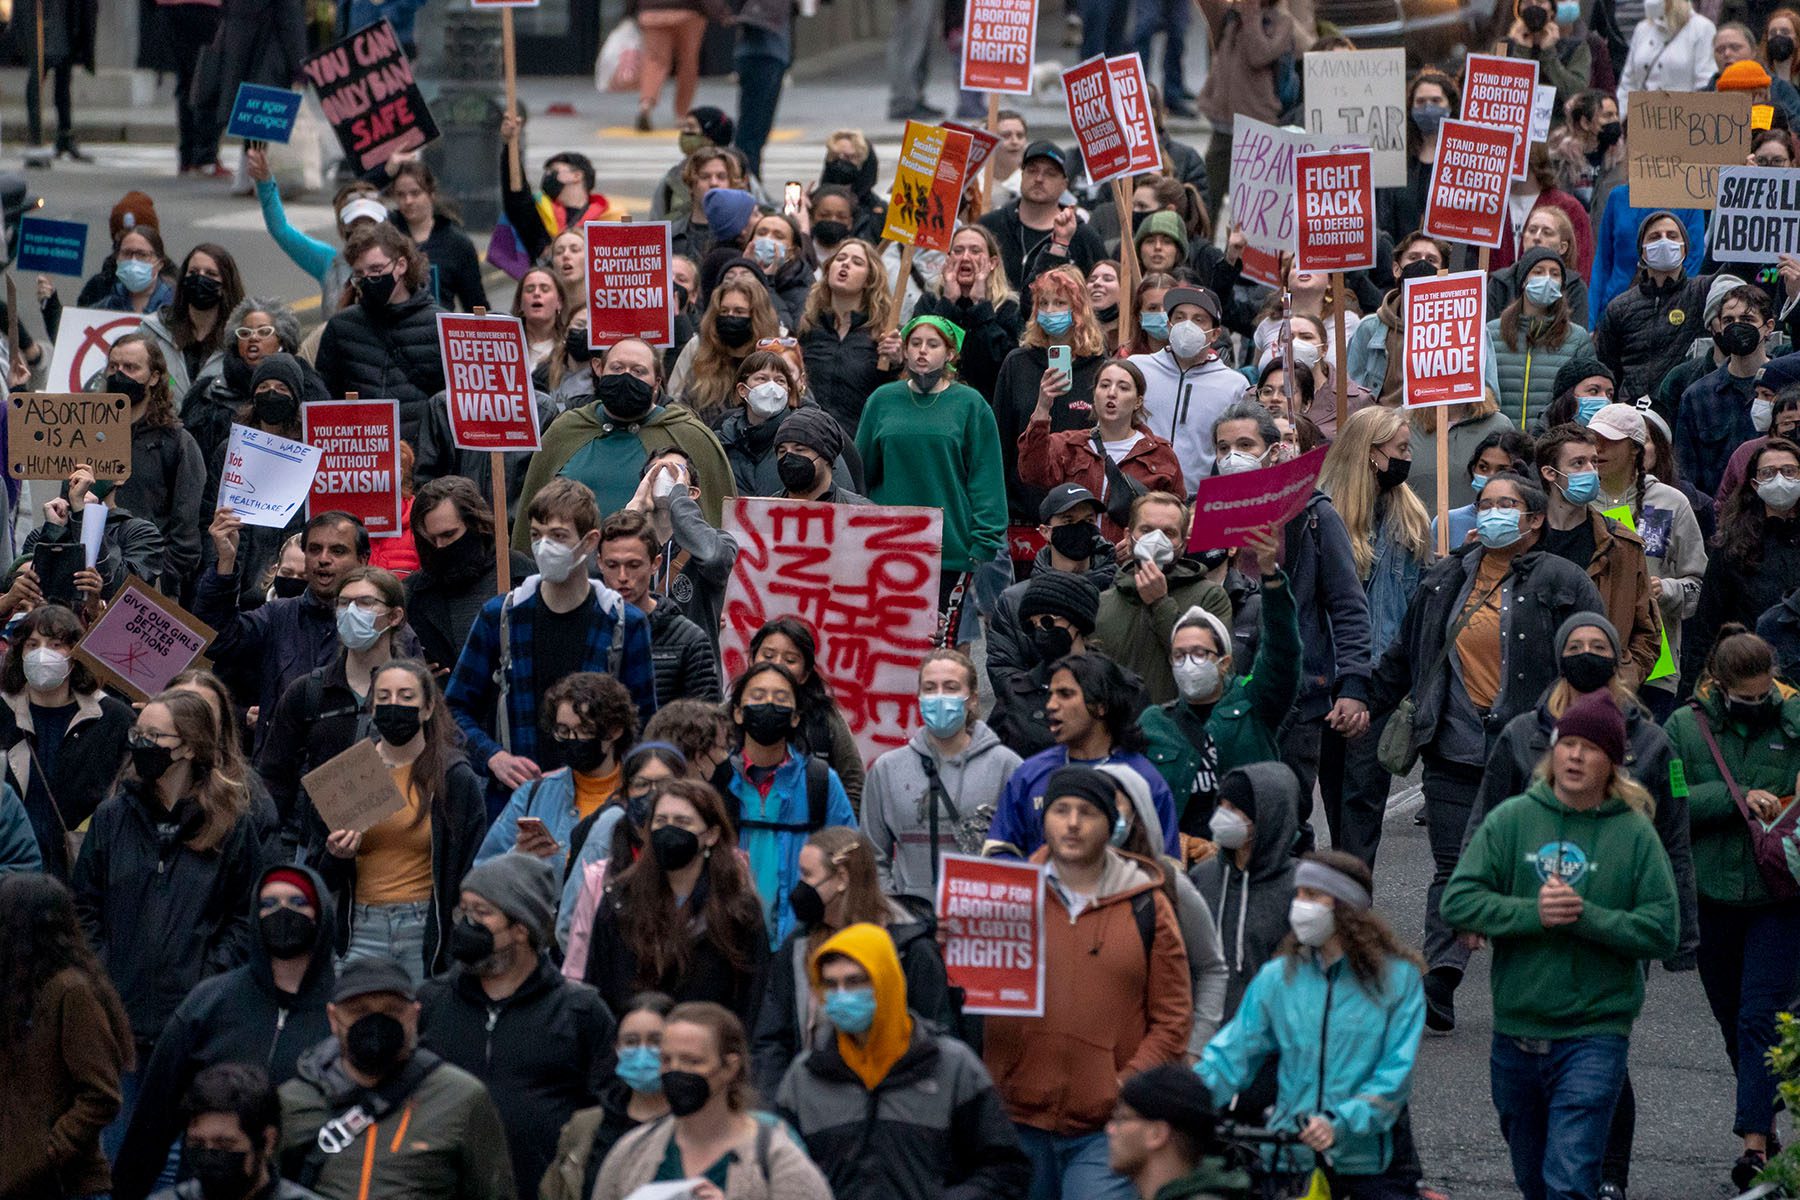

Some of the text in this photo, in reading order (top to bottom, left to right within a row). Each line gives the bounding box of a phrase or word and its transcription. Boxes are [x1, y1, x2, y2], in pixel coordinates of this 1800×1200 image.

[974, 8, 1030, 25] ABORTION
[1002, 0, 1014, 8] UP
[1015, 0, 1031, 10] FOR
[972, 23, 1027, 44] & LGBTQ
[304, 23, 397, 87] YOU CAN
[970, 40, 1027, 64] RIGHTS
[1308, 60, 1399, 78] KAVANAUGH
[1473, 72, 1530, 88] STAND UP FOR
[322, 56, 414, 125] ONLY BAN
[1071, 72, 1103, 105] FIGHT
[1364, 84, 1373, 97] A
[1471, 85, 1528, 104] ABORTION
[246, 100, 260, 108] MY
[1074, 95, 1111, 130] BACK
[1469, 101, 1480, 118] &
[1483, 102, 1525, 124] LGBTQ
[238, 112, 252, 122] MY
[352, 96, 416, 150] SAFE
[1635, 102, 1687, 130] THEIR
[1689, 113, 1750, 146] BODY
[1083, 121, 1116, 142] TO DEFEND
[1088, 132, 1121, 157] ABORTION
[1446, 138, 1507, 157] STAND UP FOR
[1444, 150, 1505, 173] ABORTION
[1635, 153, 1685, 179] THEIR
[1306, 165, 1362, 190] FIGHT
[1440, 166, 1501, 194] & LGBTQ
[1306, 190, 1363, 217] BACK
[1436, 186, 1499, 215] RIGHTS
[1720, 177, 1768, 209] SAFE
[1767, 179, 1777, 210] &
[1232, 182, 1279, 237] OUR
[1308, 216, 1364, 231] TO DEFEND
[1308, 230, 1364, 246] ABORTION
[594, 245, 661, 256] YOU CAN'T HAVE
[594, 257, 661, 272] CAPITALISM
[604, 273, 652, 287] WITHOUT
[595, 287, 663, 309] SEXISM
[1440, 289, 1468, 298] MOVEMENT
[1413, 297, 1477, 324] DEFEND
[1412, 320, 1476, 350] ROE V.
[449, 339, 519, 362] DEFEND
[1412, 346, 1474, 379] WADE
[453, 364, 523, 392] ROE V.
[25, 398, 120, 424] ABORTION
[457, 393, 526, 422] WADE
[48, 428, 87, 448] IS A
[314, 425, 388, 436] YOU CAN'T HAVE
[242, 430, 258, 440] ROE
[280, 443, 311, 456] WADE
[314, 438, 389, 453] CAPITALISM
[27, 455, 78, 474] HUMAN
[325, 455, 378, 468] WITHOUT
[315, 471, 390, 494] SEXISM
[848, 515, 943, 649] NOW
[123, 594, 199, 652] GIVE OUR GIRLS
[134, 615, 174, 647] BETTER
[126, 622, 170, 656] OPTIONS
[950, 879, 1032, 901] STAND UP FOR
[948, 897, 1032, 921] ABORTION
[948, 919, 1032, 942] & LGBTQ
[947, 936, 1032, 970] RIGHTS
